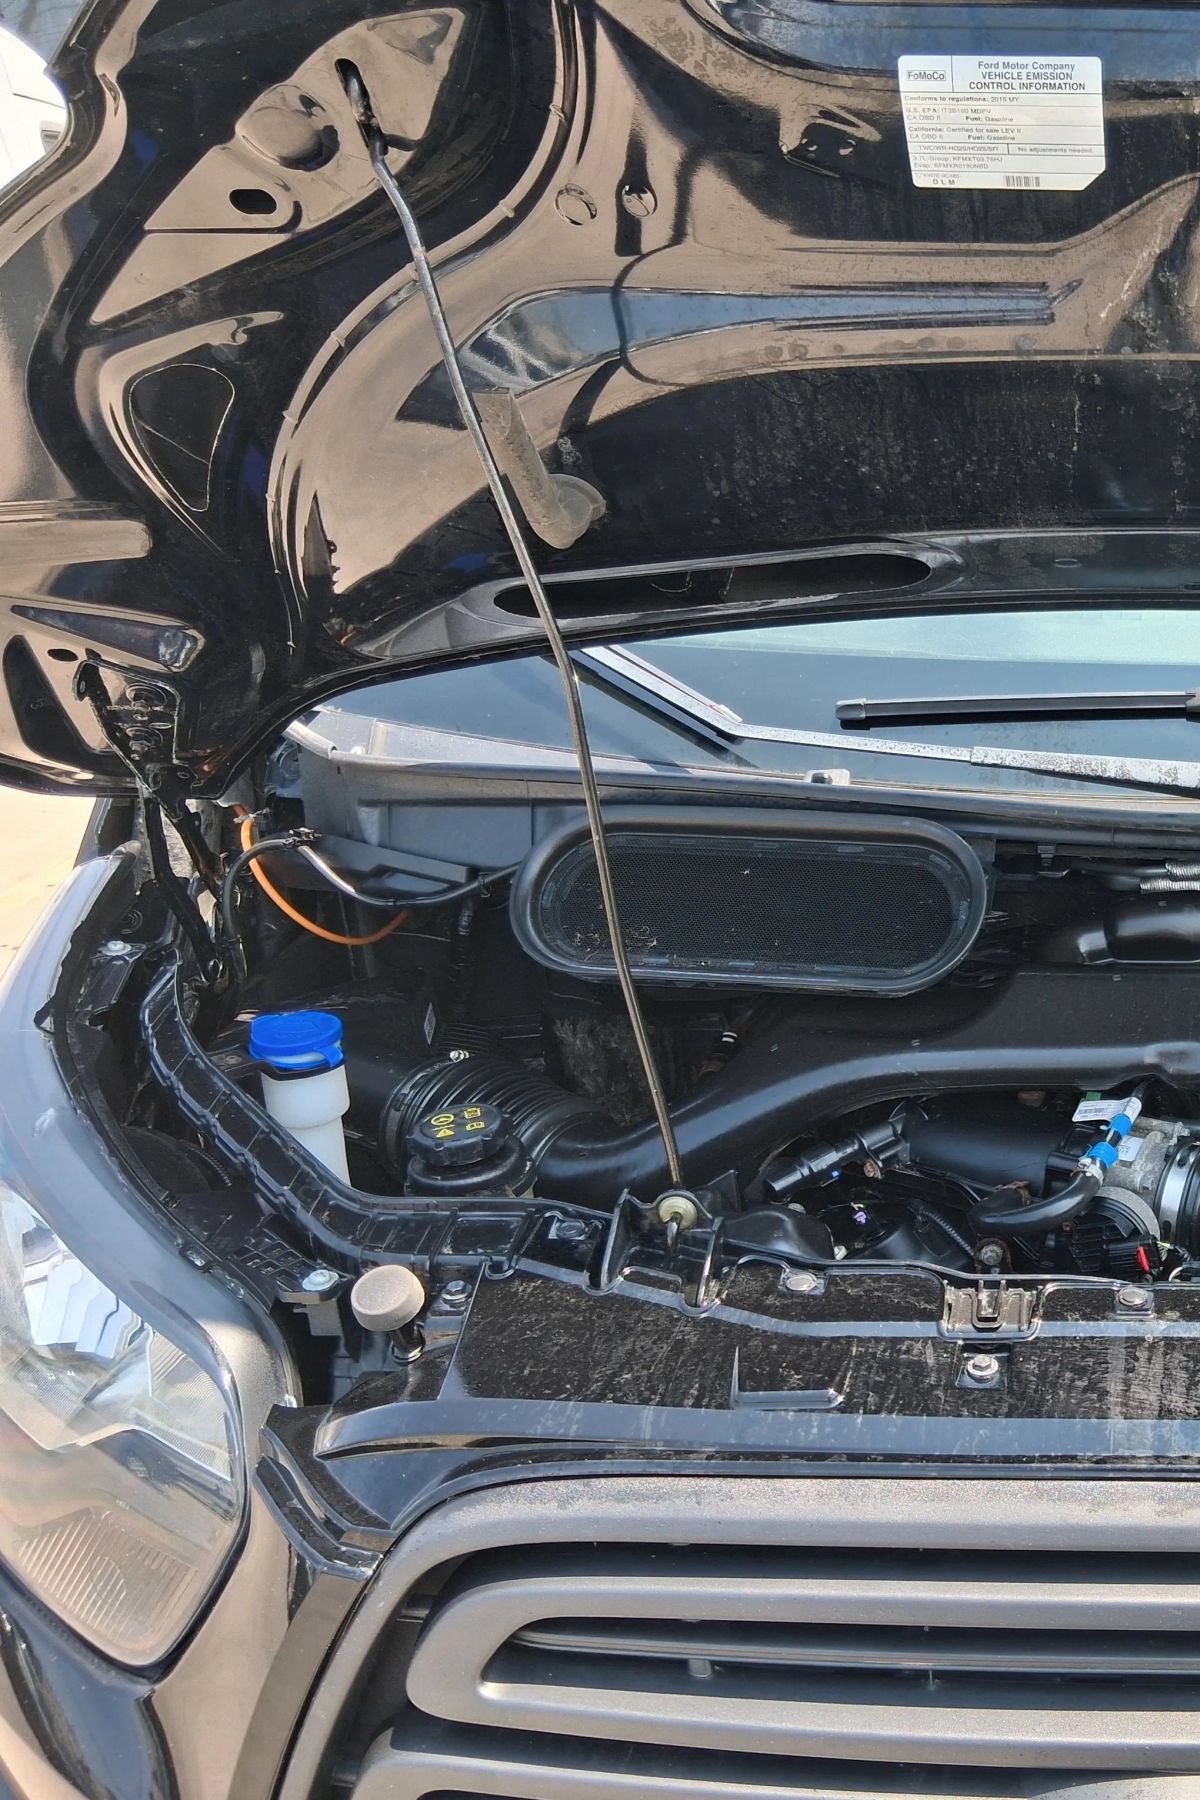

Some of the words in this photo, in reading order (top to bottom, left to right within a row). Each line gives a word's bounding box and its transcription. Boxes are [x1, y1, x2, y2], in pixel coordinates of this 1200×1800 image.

[978, 61, 1000, 70] Ford
[1002, 61, 1029, 70] Motor
[1032, 61, 1075, 72] Company
[908, 71, 946, 81] FoMoCo
[981, 71, 1023, 80] VEHICLE
[1026, 72, 1073, 80] EMISSION
[969, 82, 1016, 90] CONTROL
[1019, 82, 1086, 91] INFORMATION
